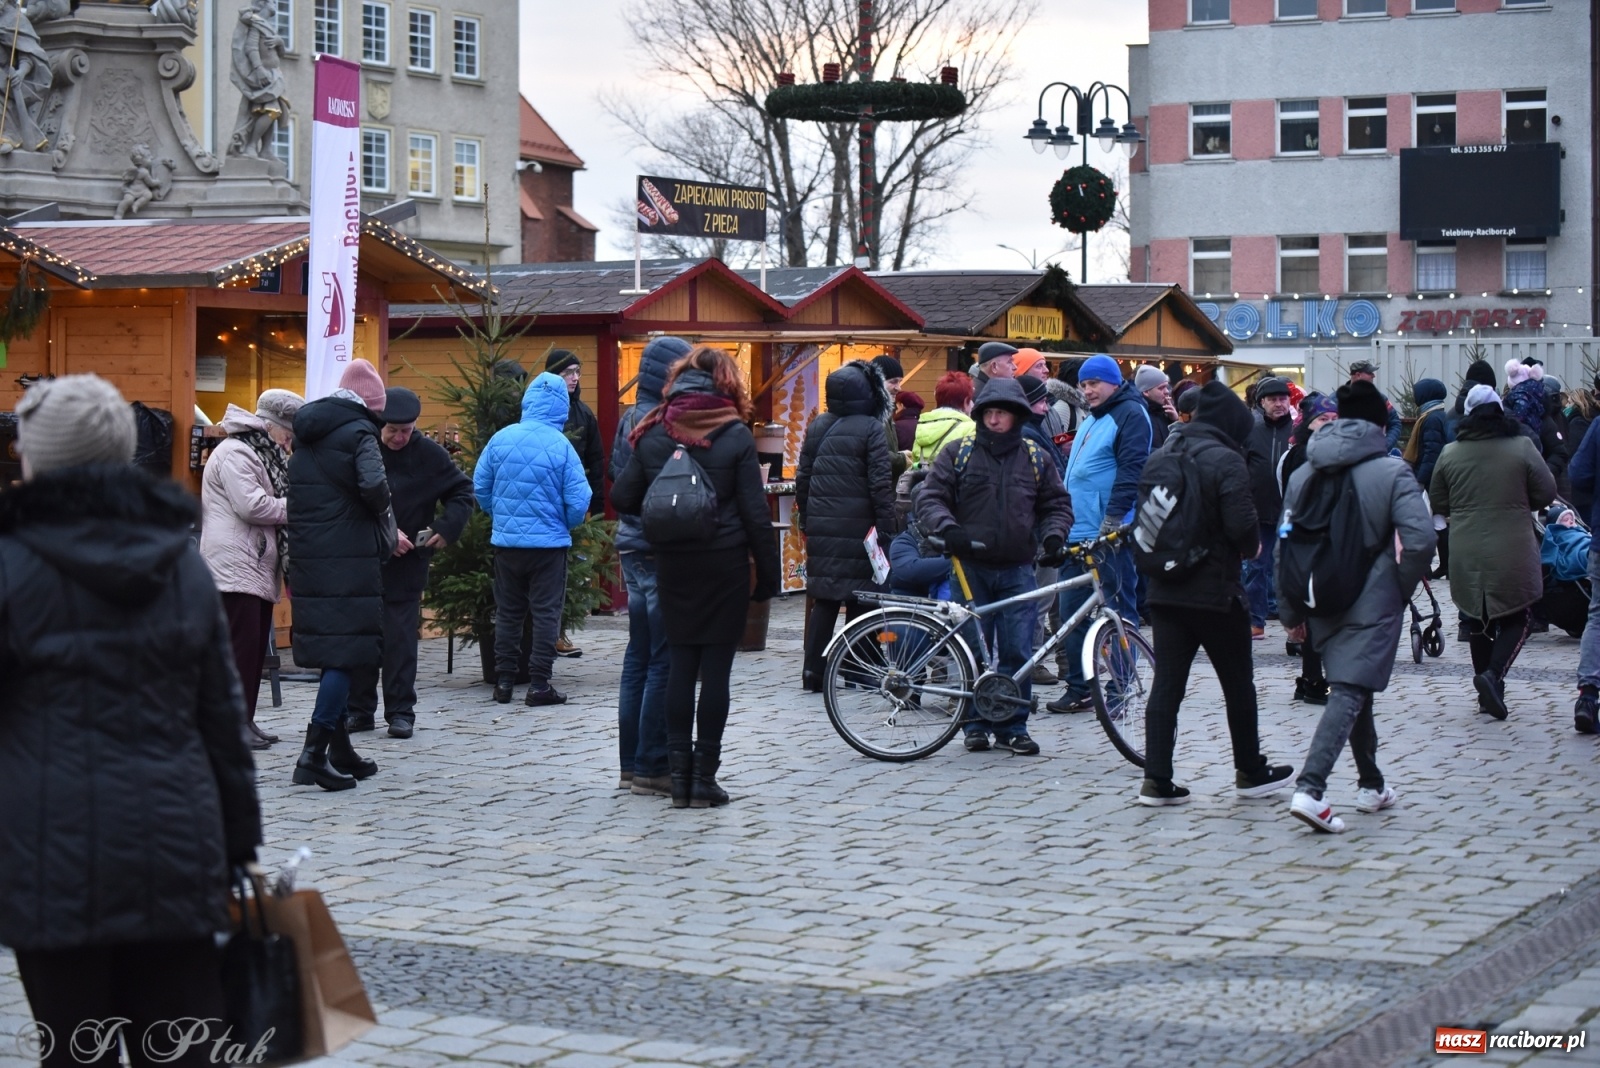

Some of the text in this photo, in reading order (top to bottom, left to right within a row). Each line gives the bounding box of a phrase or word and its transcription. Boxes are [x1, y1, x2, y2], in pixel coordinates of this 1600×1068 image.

[1450, 144, 1507, 154] tel. 533 355 677
[673, 183, 766, 211] ZAPIEKANKI PROSTO
[703, 213, 739, 234] Z PIECA
[1441, 227, 1517, 238] Telebimy-Raciborz.pl
[1396, 308, 1547, 336] zaprasza
[1133, 485, 1178, 553] NIKE
